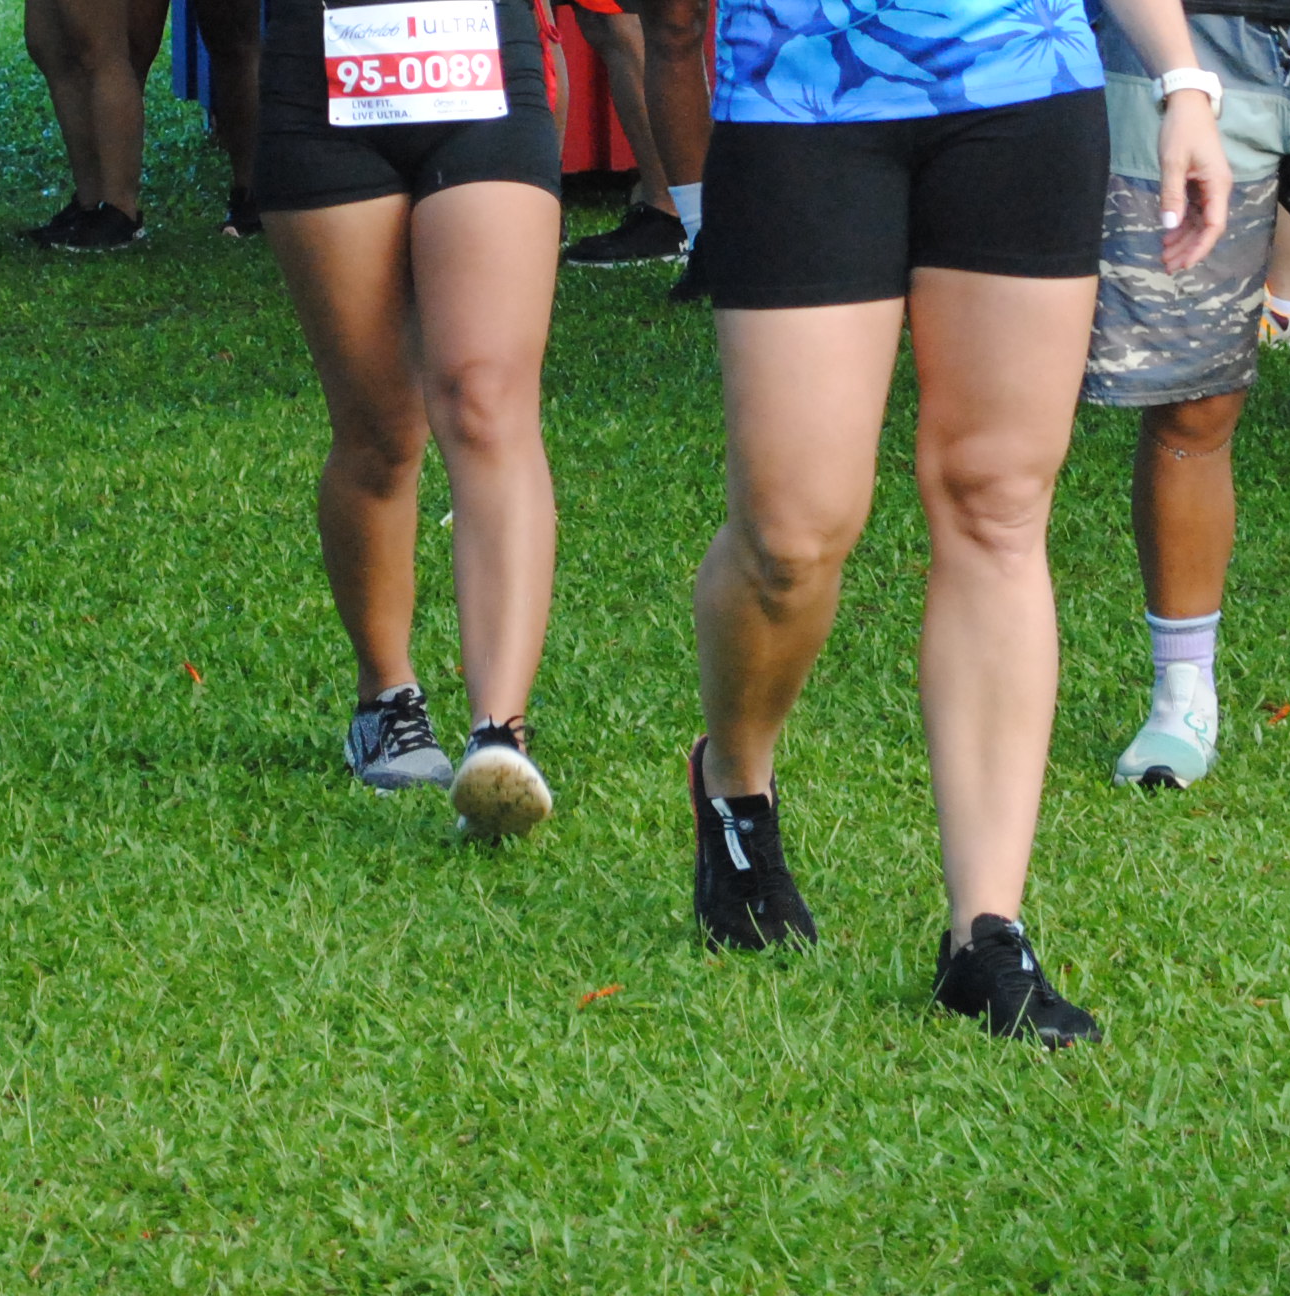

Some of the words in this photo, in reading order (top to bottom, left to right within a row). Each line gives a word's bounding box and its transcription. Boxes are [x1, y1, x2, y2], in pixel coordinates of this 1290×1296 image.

[327, 23, 400, 42] Michelob
[423, 17, 491, 34] ULTRA
[336, 53, 492, 93] 95-0089
[351, 99, 374, 109] LIVE
[375, 99, 393, 109] FIT.
[352, 111, 375, 121] LIVE
[376, 110, 412, 120] ULTRA.
